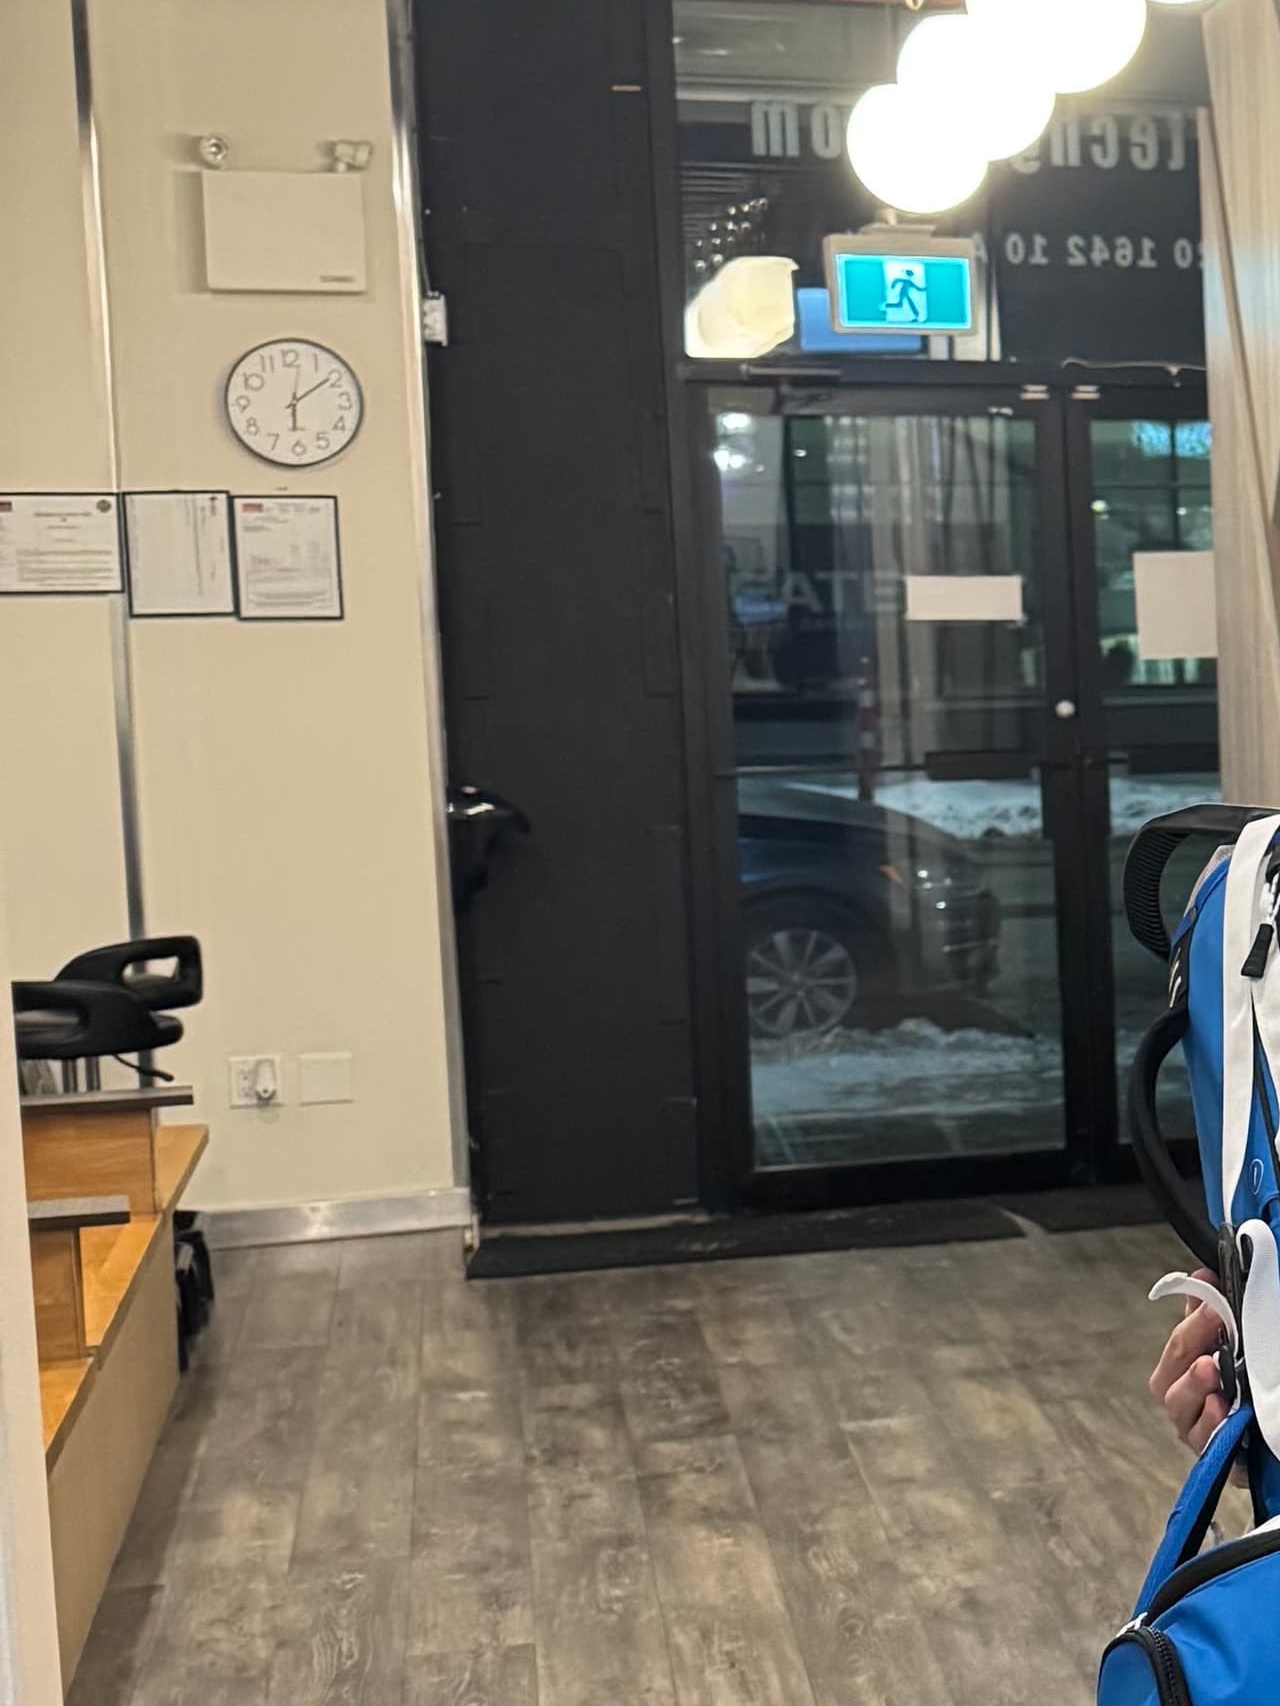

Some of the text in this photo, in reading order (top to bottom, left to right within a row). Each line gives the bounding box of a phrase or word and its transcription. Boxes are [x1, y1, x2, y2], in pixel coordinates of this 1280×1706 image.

[260, 354, 275, 373] 11
[280, 348, 301, 368] 12
[242, 373, 265, 391] 10
[328, 369, 342, 388] 2
[235, 394, 250, 413] 9
[338, 391, 352, 410] 3
[246, 417, 259, 435] 8
[333, 415, 346, 431] 4
[266, 433, 280, 451] 7
[291, 440, 306, 456] 6
[316, 432, 330, 450] 5
